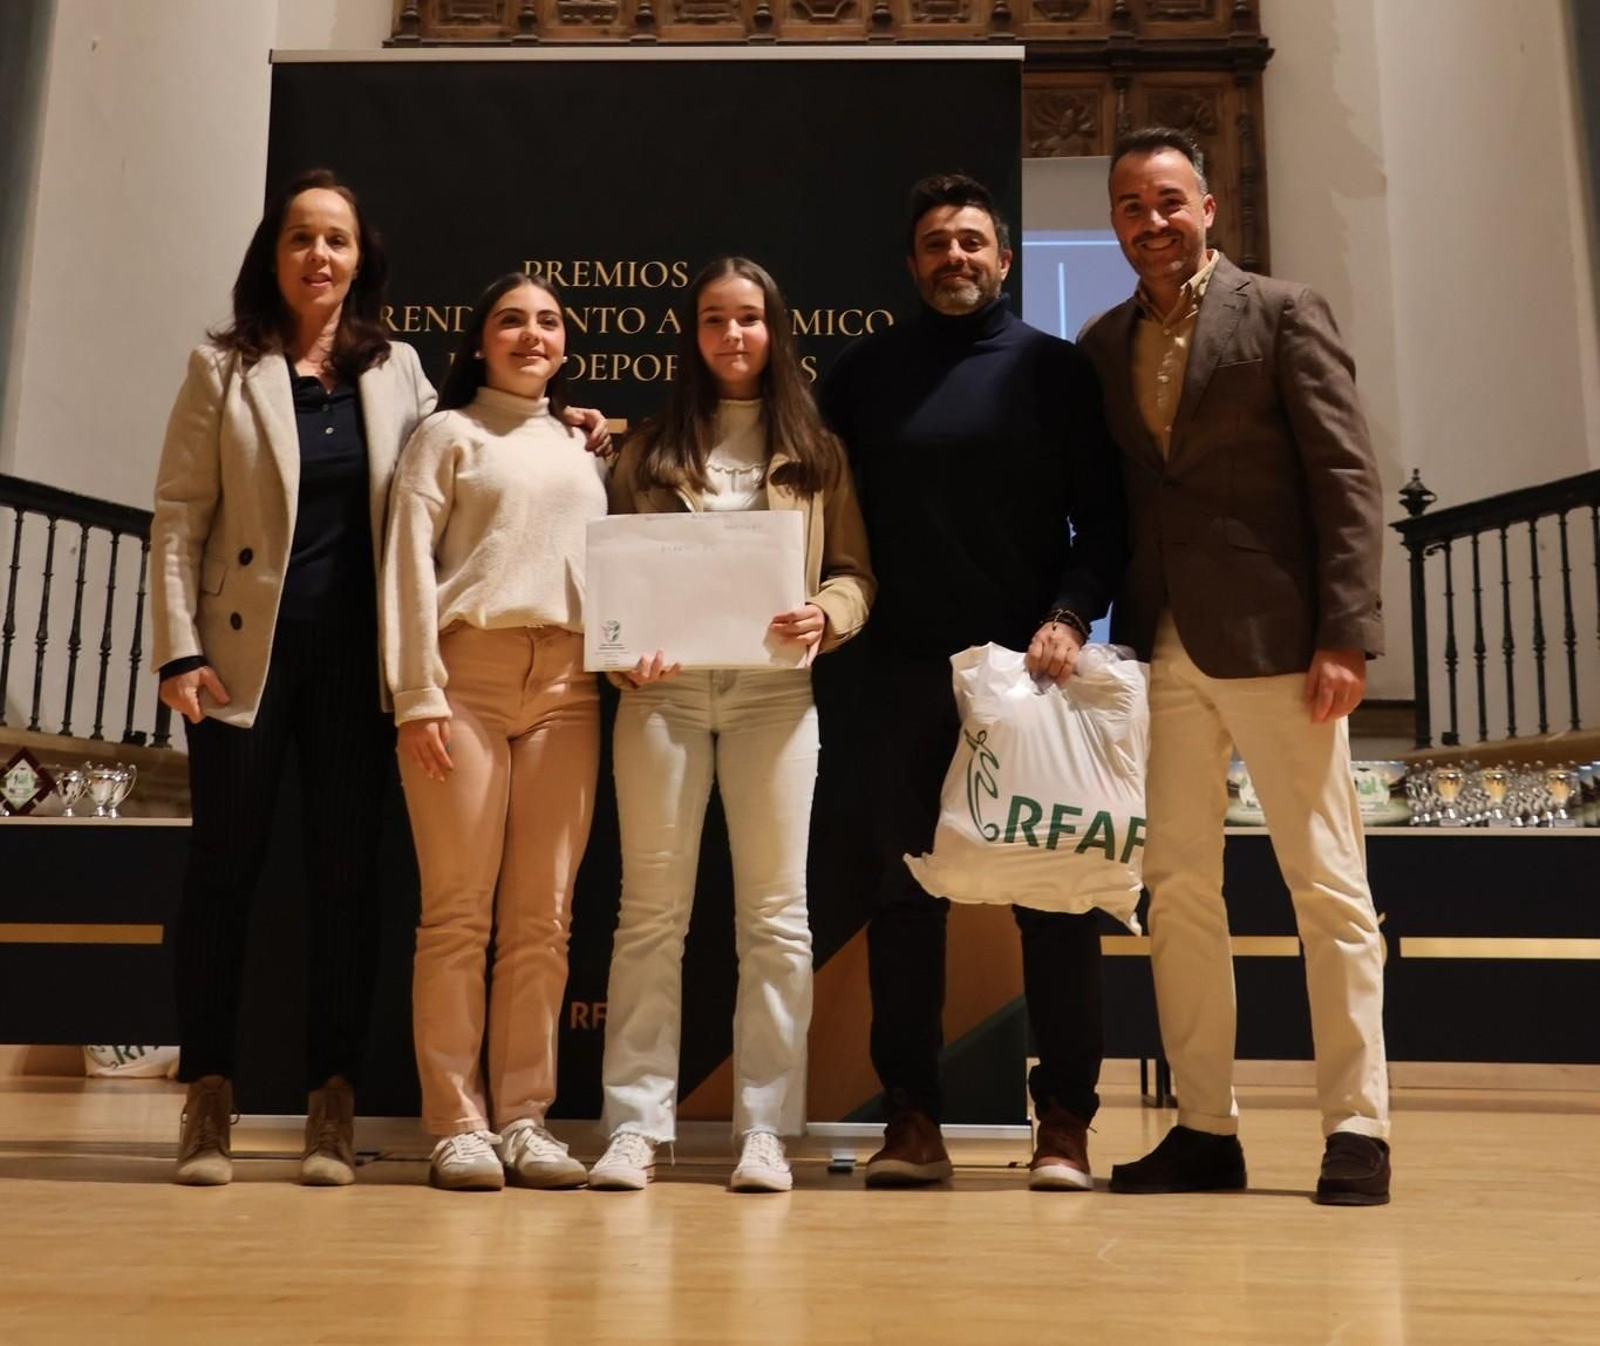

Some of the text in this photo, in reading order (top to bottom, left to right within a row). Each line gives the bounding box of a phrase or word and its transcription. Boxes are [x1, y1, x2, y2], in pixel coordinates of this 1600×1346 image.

[523, 260, 689, 288] PREMIOS
[655, 307, 895, 337] AMICO
[1003, 795, 1146, 864] RFAF
